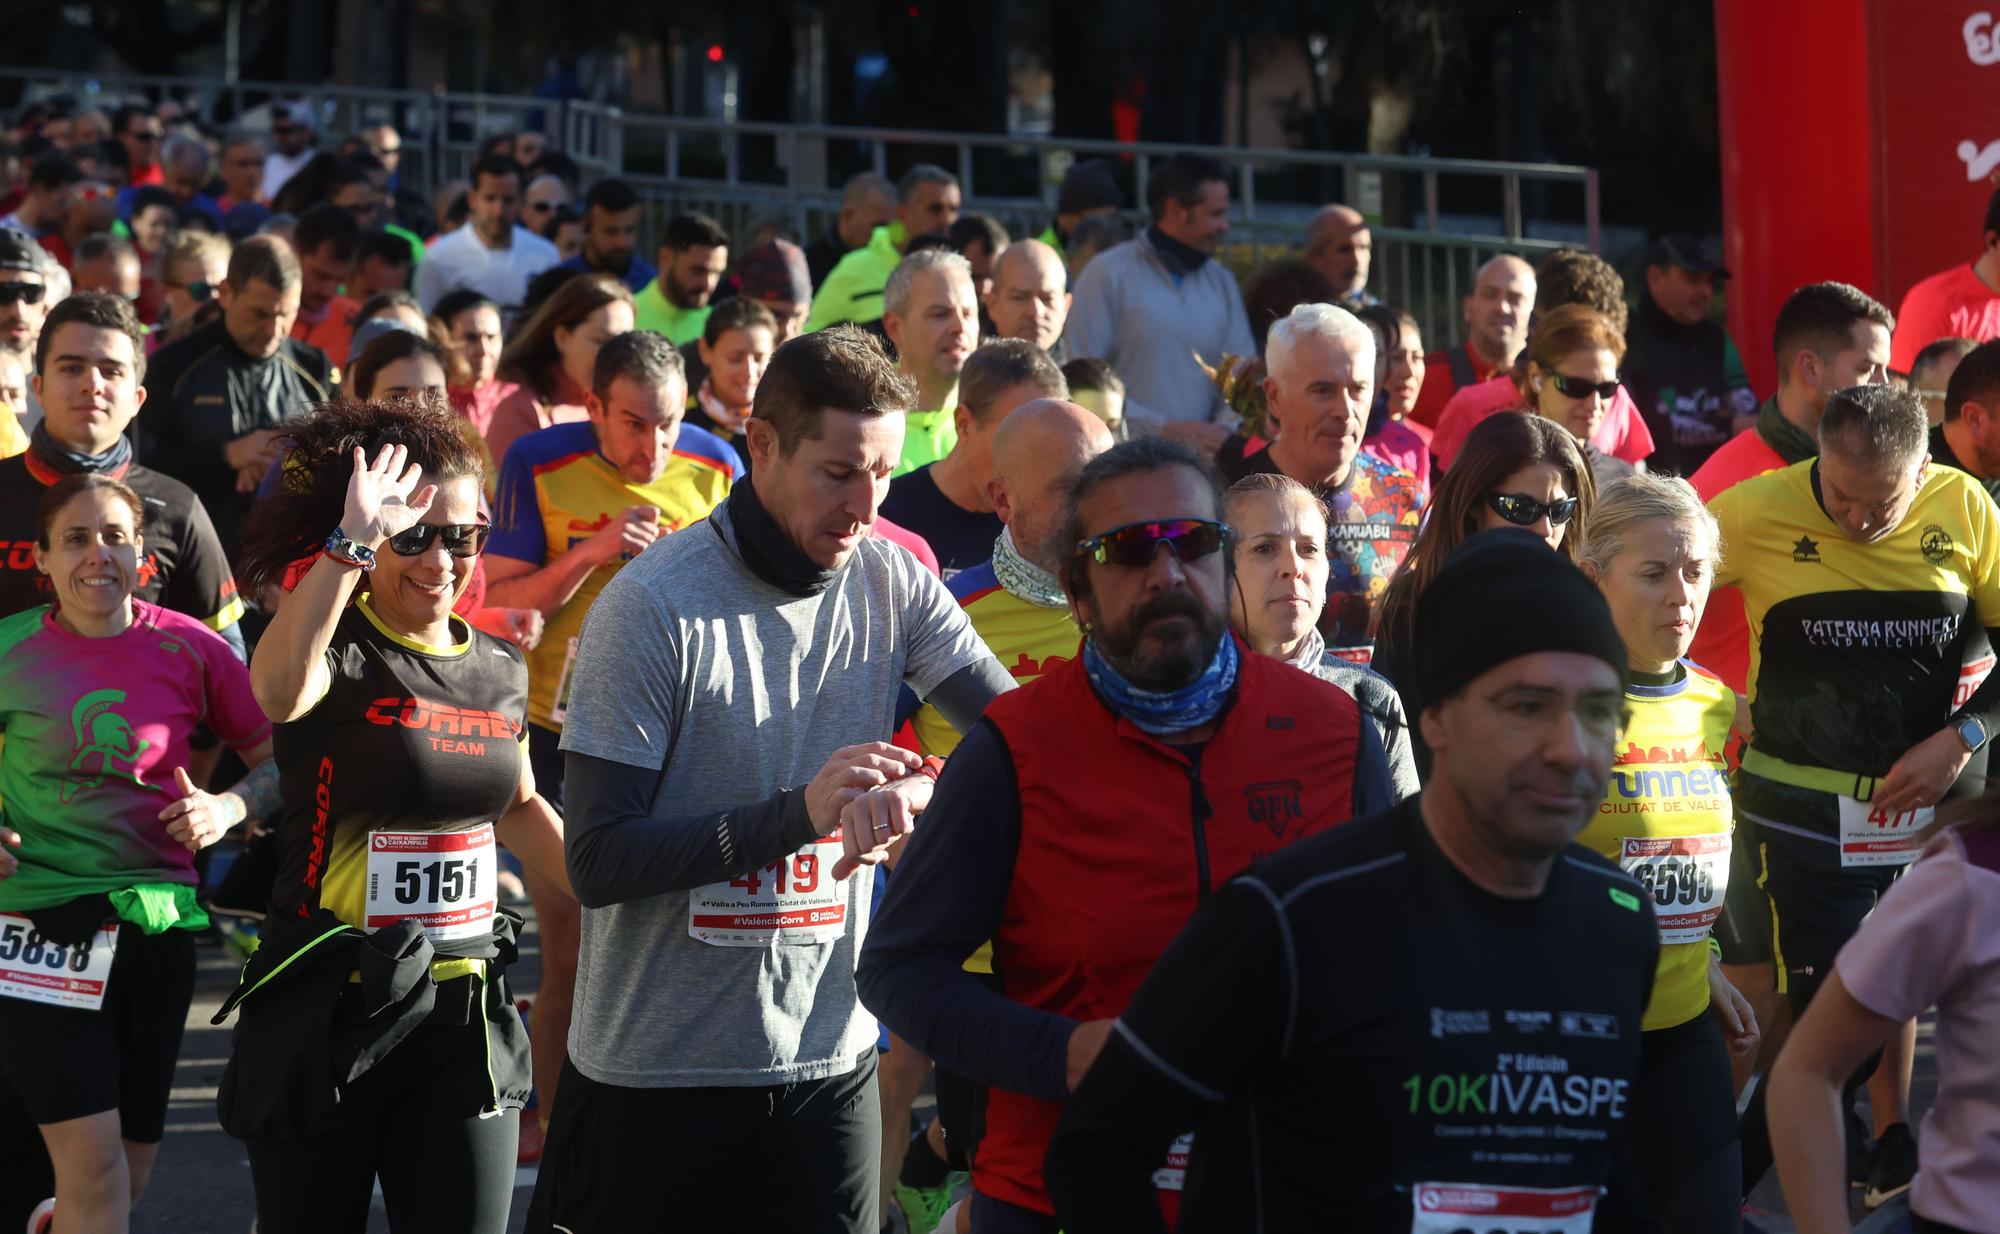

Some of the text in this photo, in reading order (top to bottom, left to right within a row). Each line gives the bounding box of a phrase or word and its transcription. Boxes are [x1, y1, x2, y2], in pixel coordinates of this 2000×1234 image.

[1802, 614, 1960, 638] PATERNA RUNNERS
[365, 697, 512, 739] CORRE
[429, 737, 485, 756] TEAM
[1600, 802, 1656, 814] CIUTAT
[1664, 802, 1683, 812] DE
[395, 858, 478, 904] 5151
[730, 854, 819, 895] 419
[1634, 861, 1713, 906] 6595
[779, 899, 799, 907] Ciutat
[734, 916, 804, 926] #ValènciaCorre
[0, 923, 93, 973] 5838
[1515, 1053, 1569, 1072] Edición
[1403, 1073, 1630, 1119] 10KIVASPE
